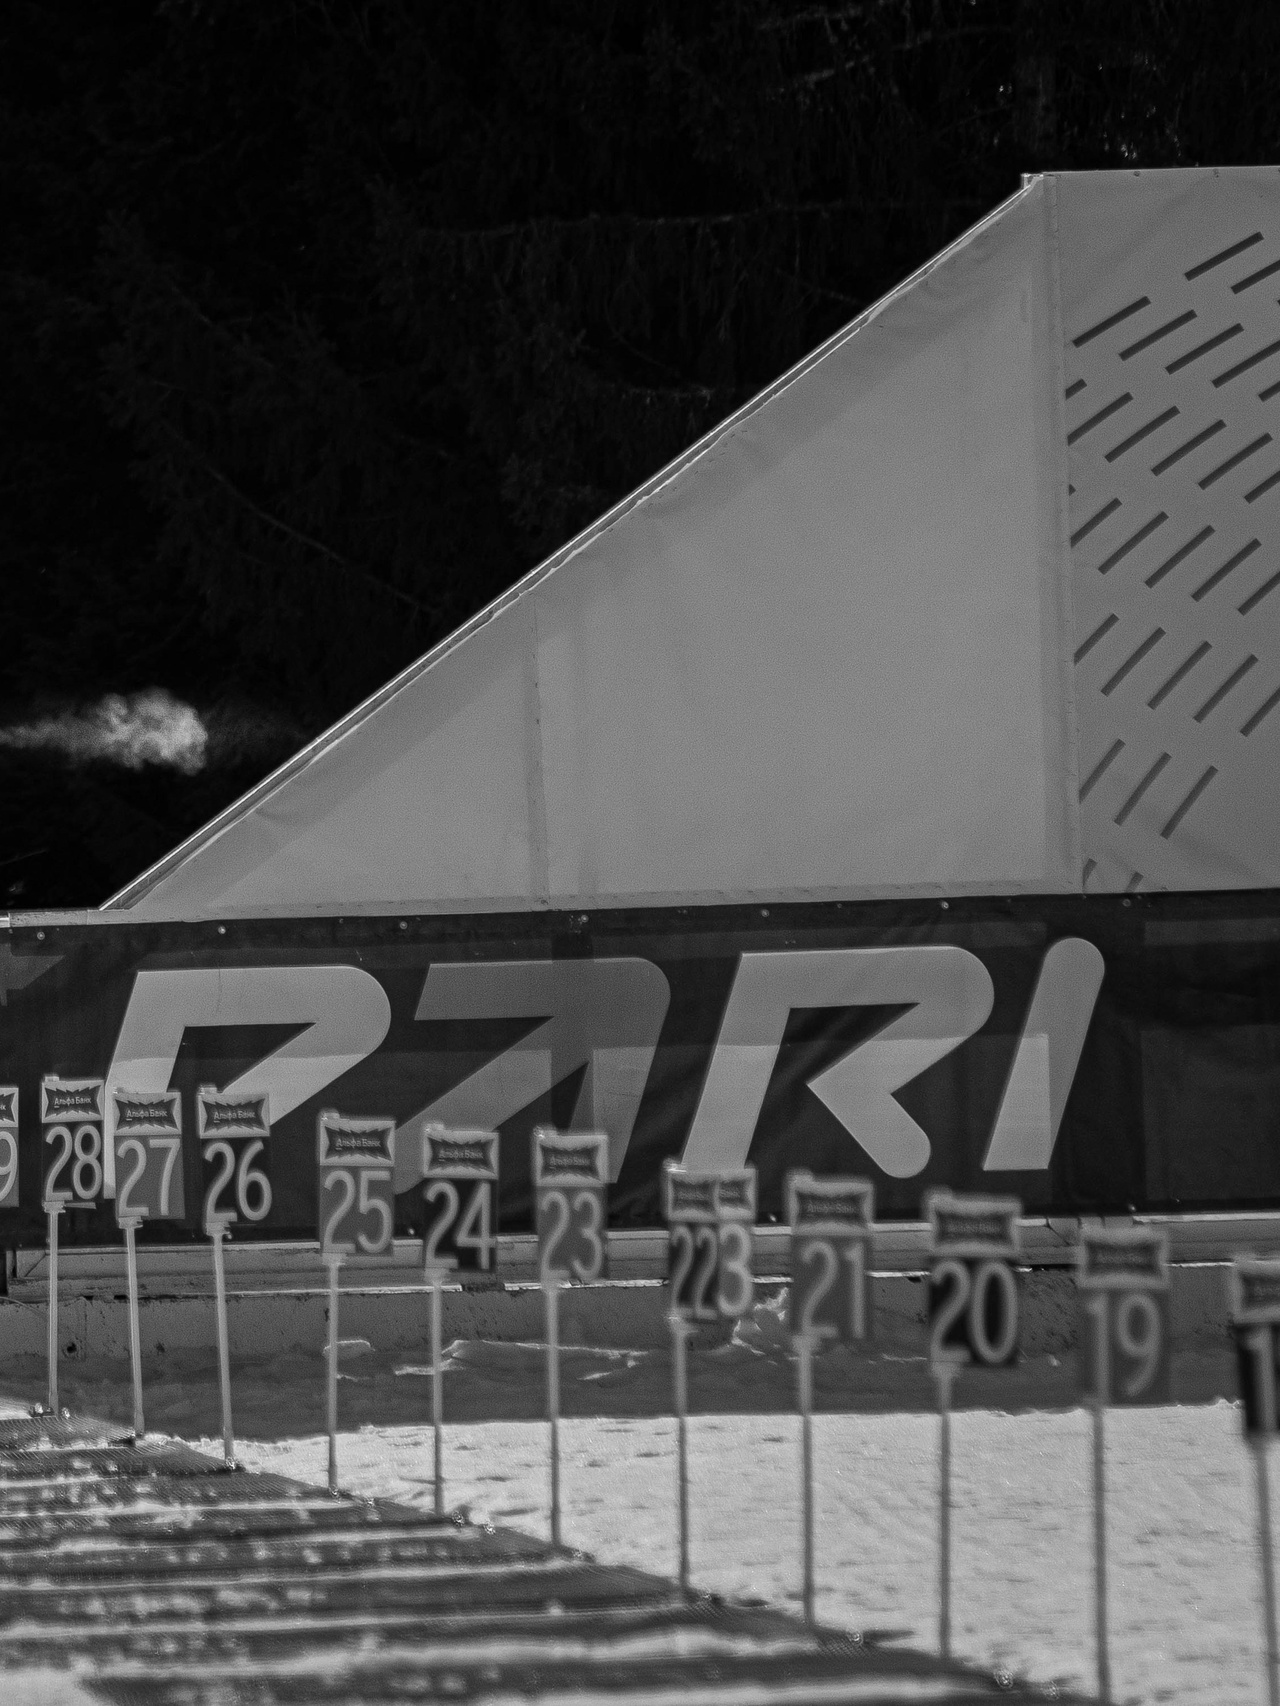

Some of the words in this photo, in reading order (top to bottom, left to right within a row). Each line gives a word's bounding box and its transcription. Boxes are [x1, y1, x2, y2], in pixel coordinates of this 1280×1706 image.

[104, 937, 1105, 1198] PARI
[45, 1124, 102, 1201] 28
[116, 1138, 181, 1218] 27
[204, 1139, 272, 1222] 26
[323, 1169, 391, 1254] 25
[425, 1180, 496, 1270] 24
[541, 1190, 603, 1281] 23
[800, 1239, 865, 1339] 21
[931, 1261, 1018, 1363] 20
[1084, 1292, 1161, 1401] 19
[1244, 1328, 1273, 1436] 1
